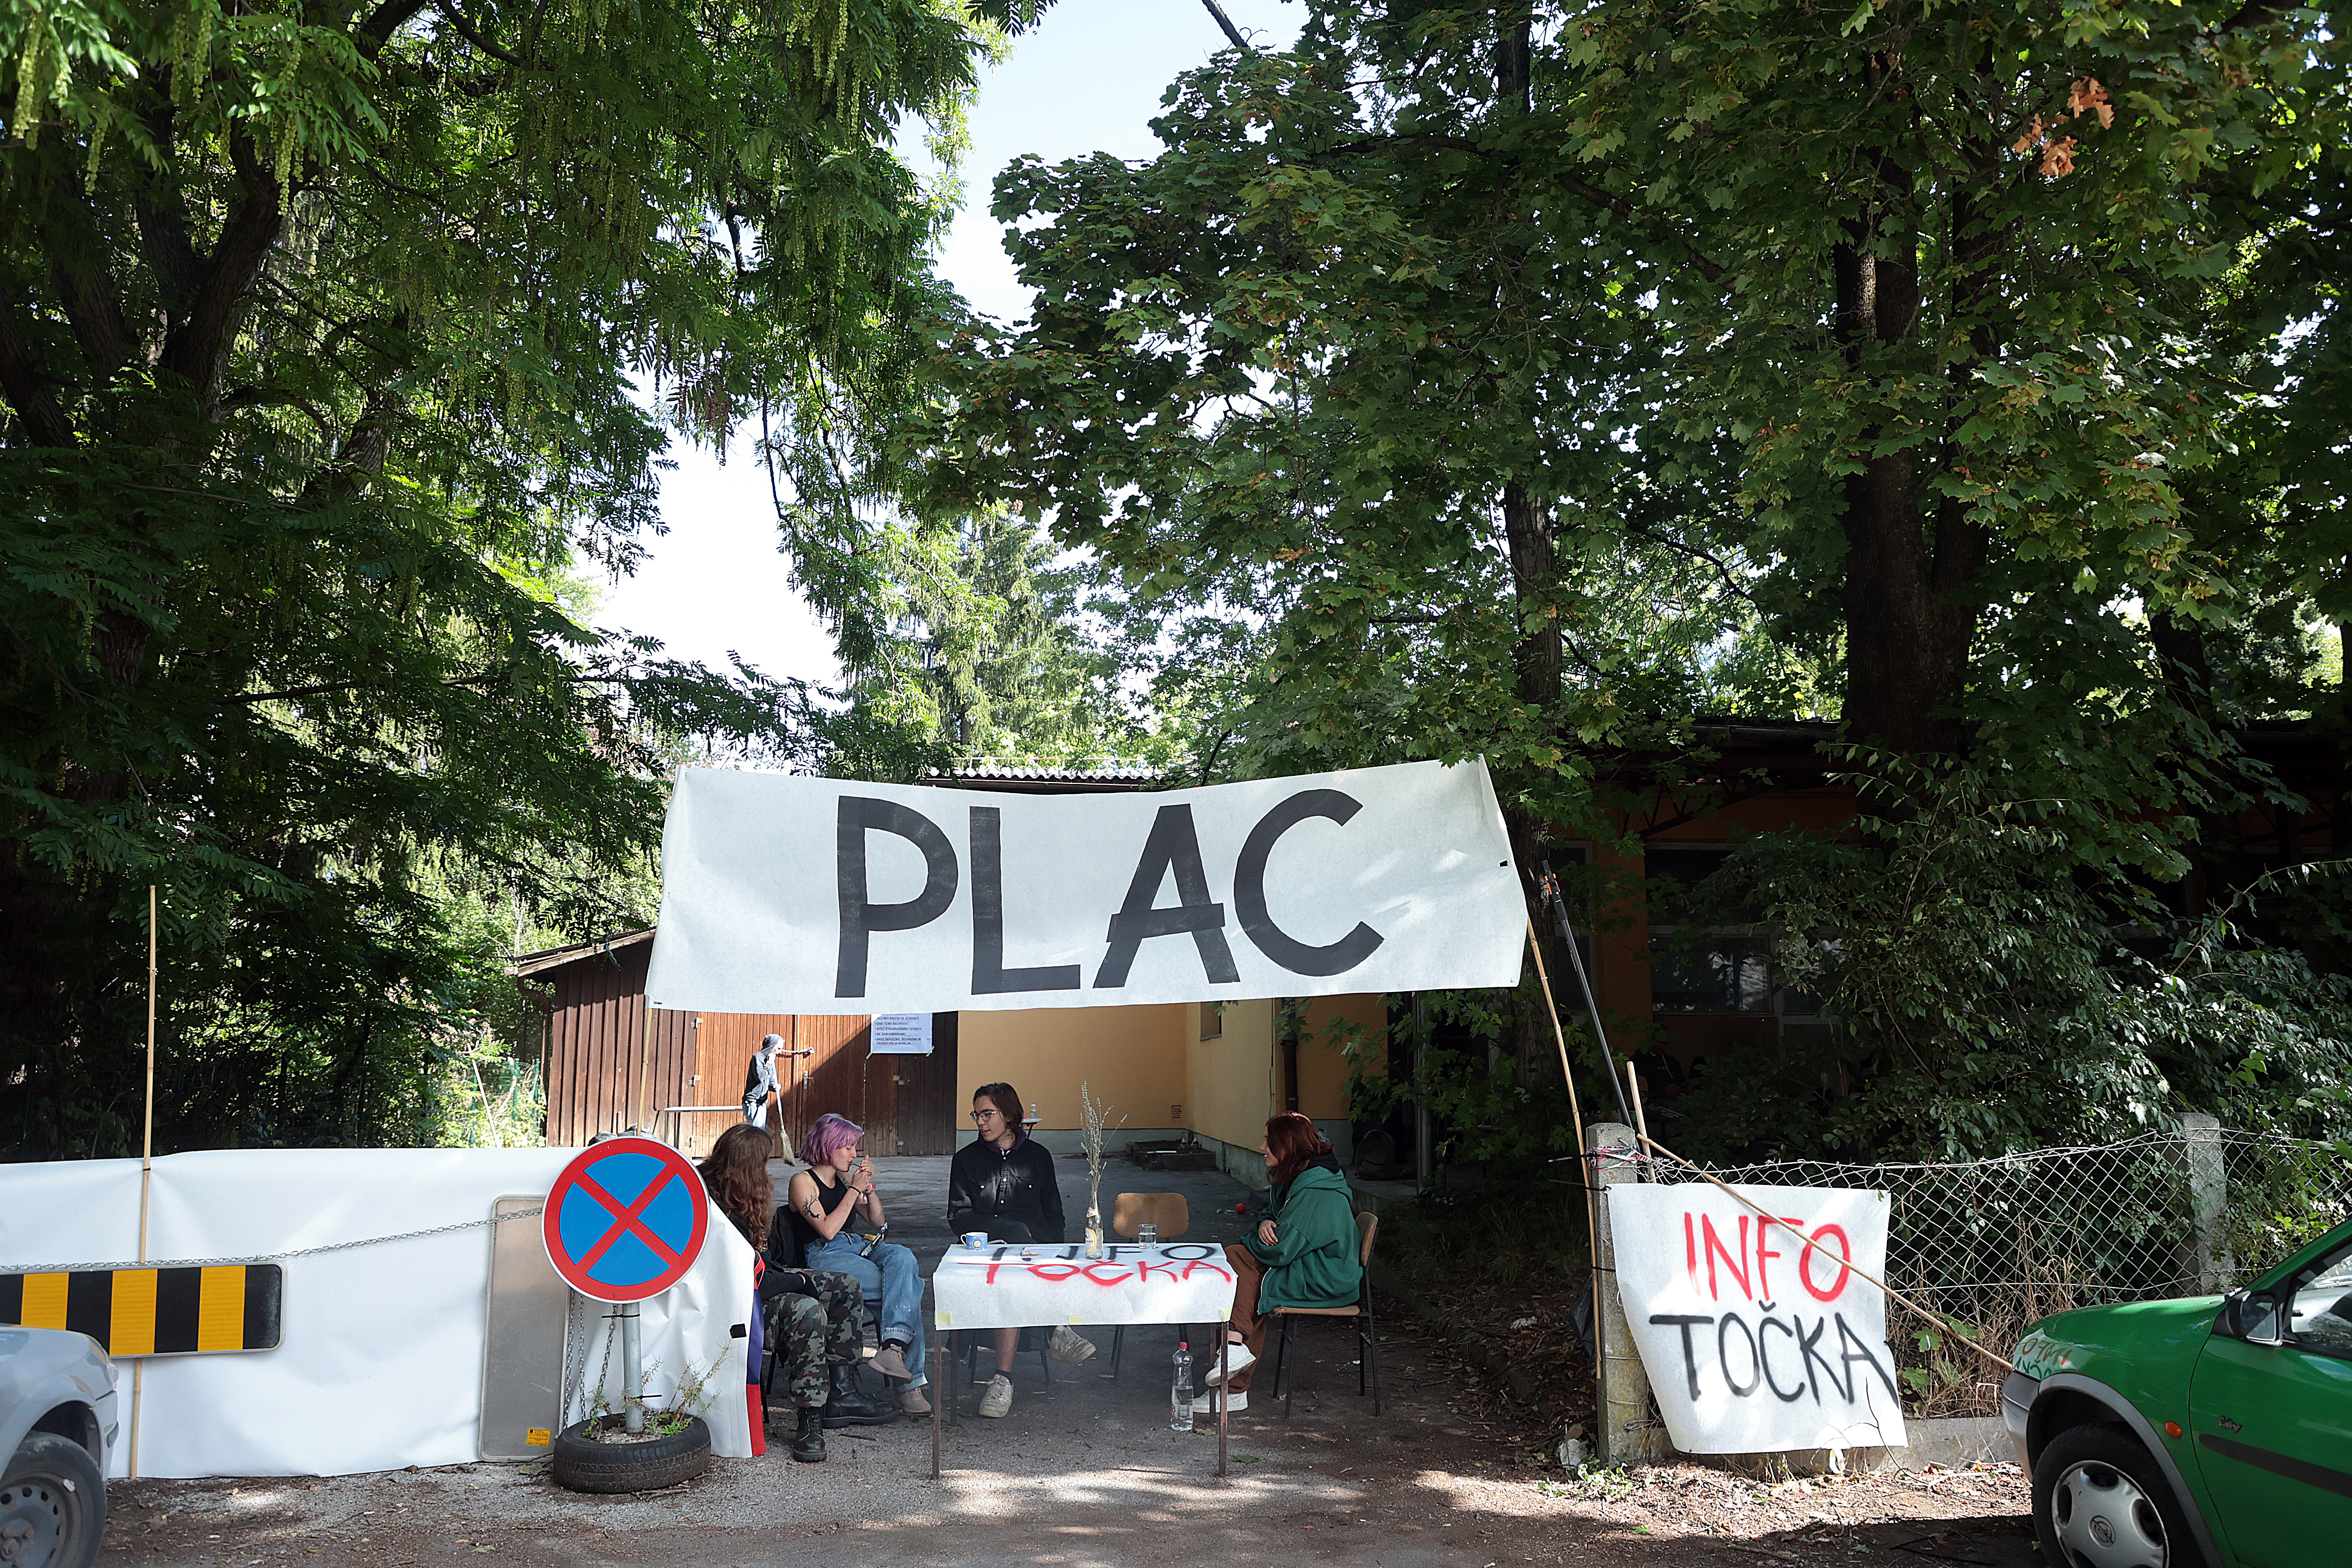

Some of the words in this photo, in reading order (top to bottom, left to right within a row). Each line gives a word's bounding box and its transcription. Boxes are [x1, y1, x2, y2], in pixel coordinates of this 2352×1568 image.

[835, 788, 1384, 998] PLAC
[956, 1260, 1232, 1286] TOČKA
[1684, 1211, 1851, 1302] INFO
[1649, 1299, 1900, 1409] TOČKA
